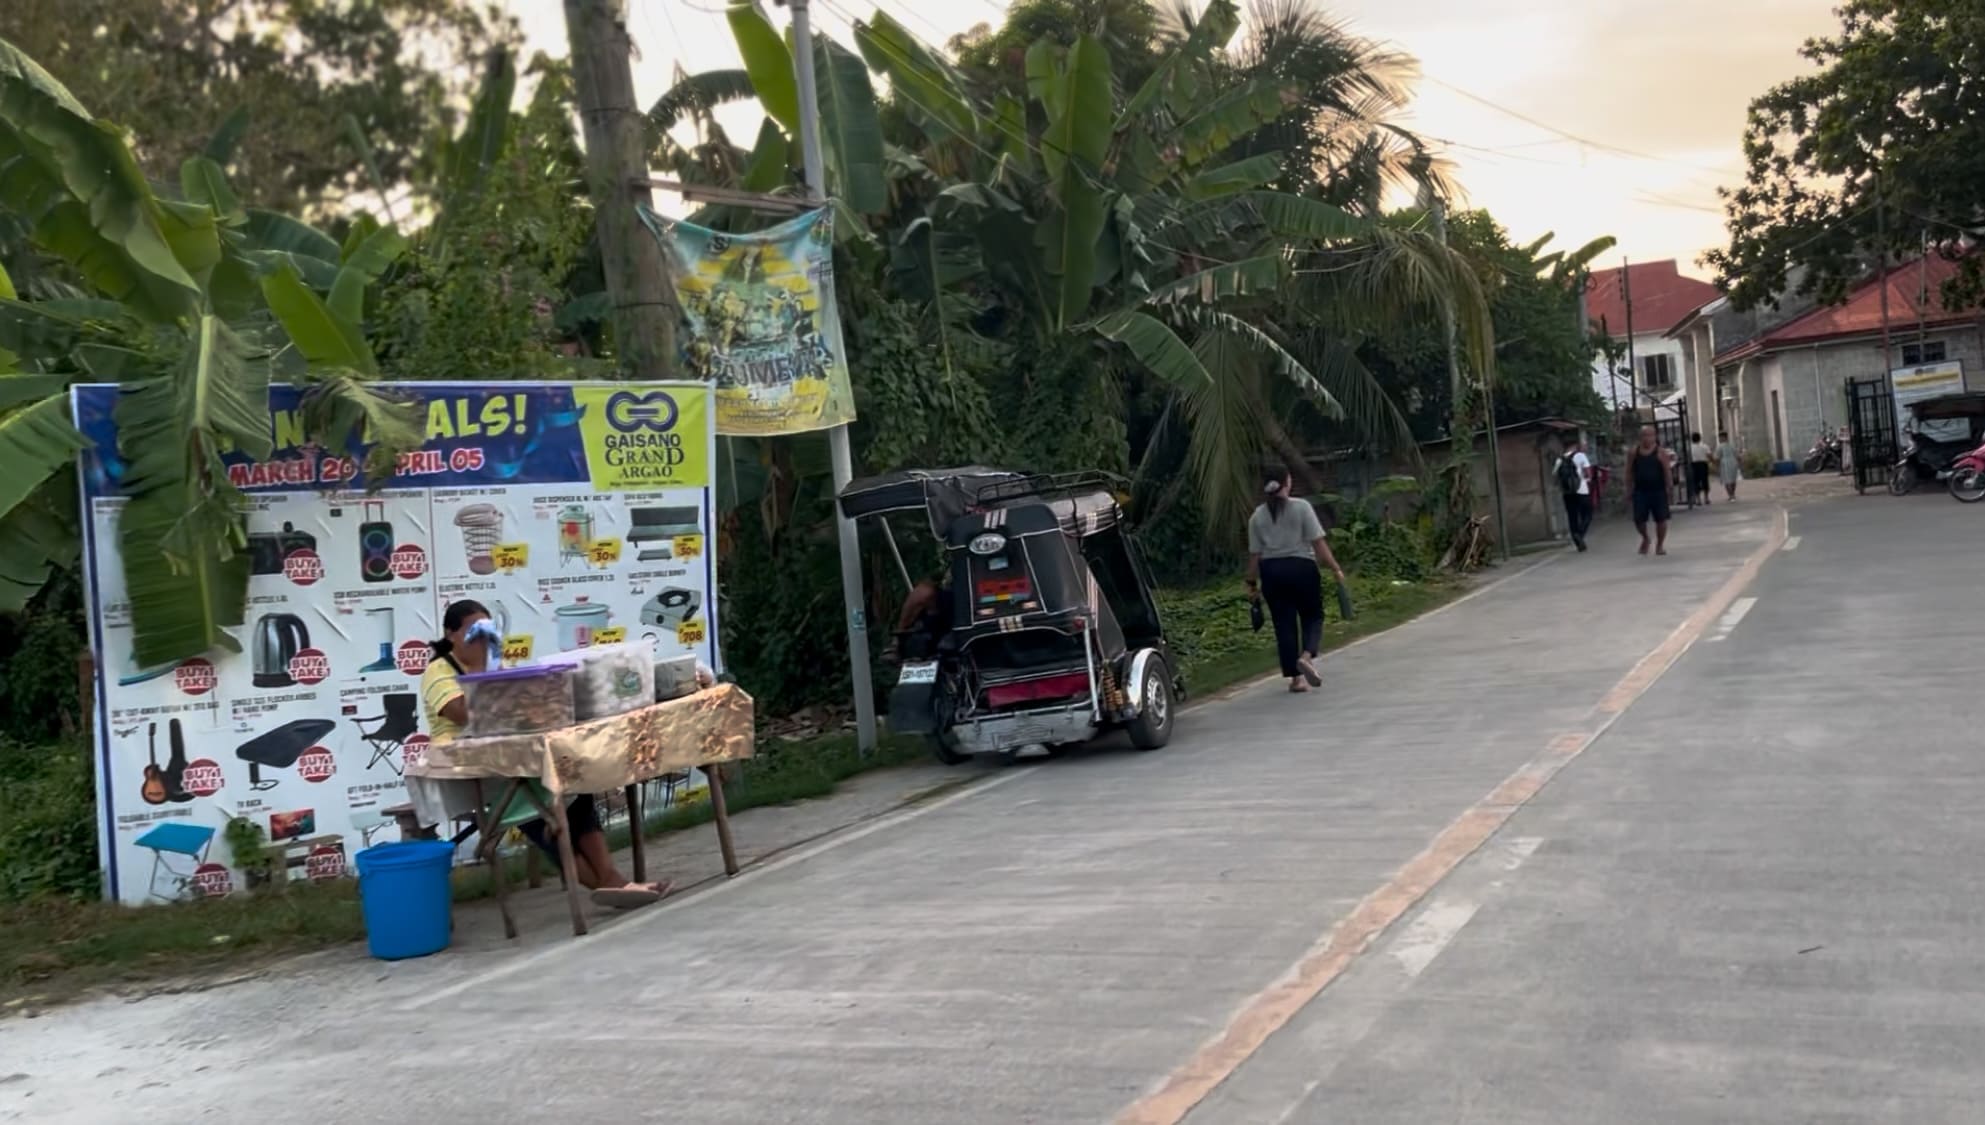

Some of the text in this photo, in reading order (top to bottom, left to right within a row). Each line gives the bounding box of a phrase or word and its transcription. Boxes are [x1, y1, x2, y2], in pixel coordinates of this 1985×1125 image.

[605, 433, 681, 448] GAISANO
[605, 447, 684, 466] GRAND
[229, 461, 316, 488] MARCH
[394, 450, 448, 476] PRIL
[450, 447, 485, 472] 05
[621, 467, 673, 479] ARGAO
[392, 553, 419, 563] BUY
[286, 559, 316, 569] BUY
[391, 563, 421, 572] TAKE
[285, 569, 317, 578] TAKE
[398, 649, 422, 659] BUY
[292, 657, 320, 668] BUY
[397, 659, 426, 670] TAKE
[175, 666, 205, 678] BUY
[290, 667, 323, 678] TAKE
[175, 677, 210, 689] TAKE
[299, 755, 326, 766] BUY
[184, 768, 212, 780] BUY
[297, 765, 328, 776] TAKE
[183, 779, 216, 790] TAKE
